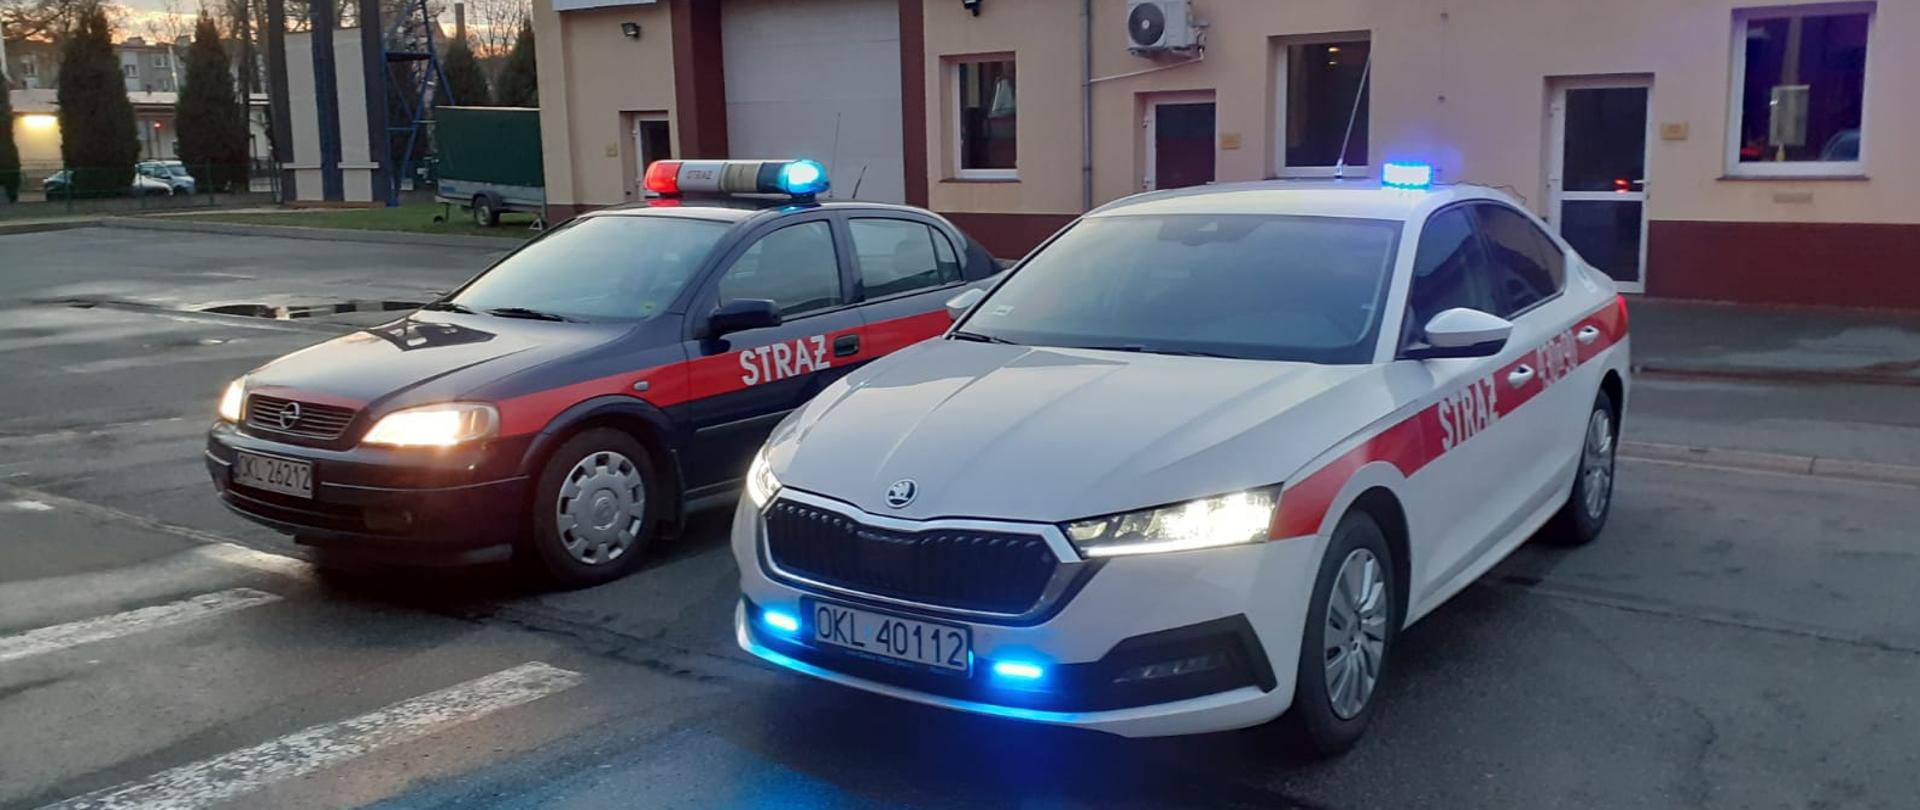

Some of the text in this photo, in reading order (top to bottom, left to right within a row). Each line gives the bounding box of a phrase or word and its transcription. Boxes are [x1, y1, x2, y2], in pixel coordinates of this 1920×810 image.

[267, 460, 310, 491] 26212
[816, 606, 866, 647] OKL
[876, 619, 964, 667] 40112
